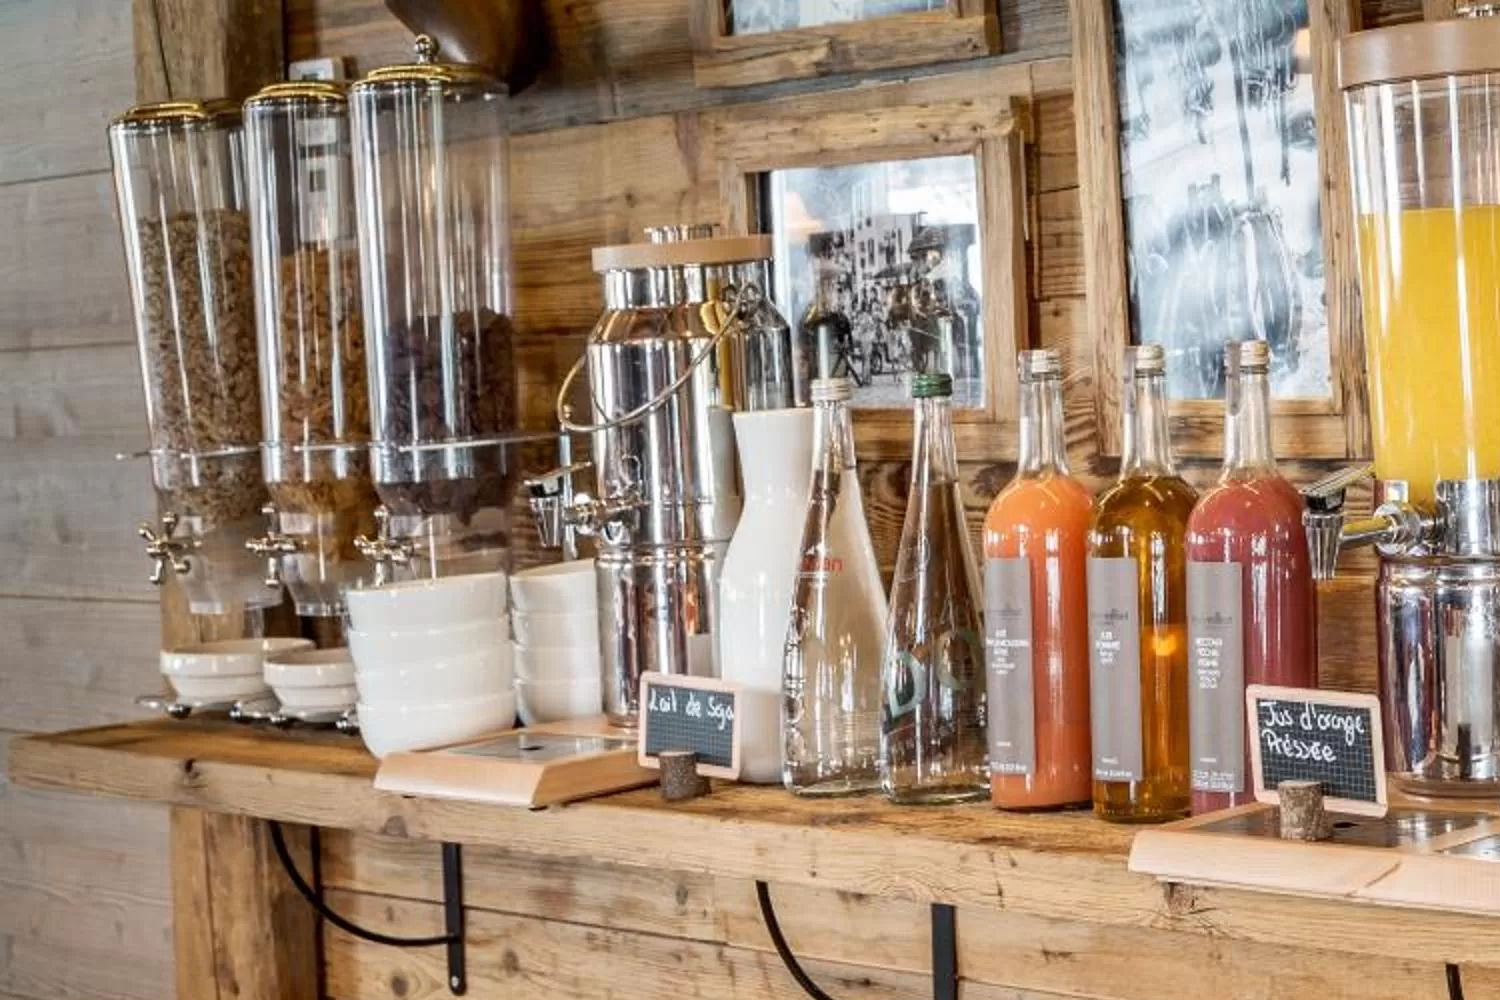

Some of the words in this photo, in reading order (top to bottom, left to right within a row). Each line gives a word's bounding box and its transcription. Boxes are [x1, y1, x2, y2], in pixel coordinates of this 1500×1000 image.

[686, 691, 702, 718] de
[1259, 701, 1294, 727] Jus
[1300, 700, 1365, 746] d'orange
